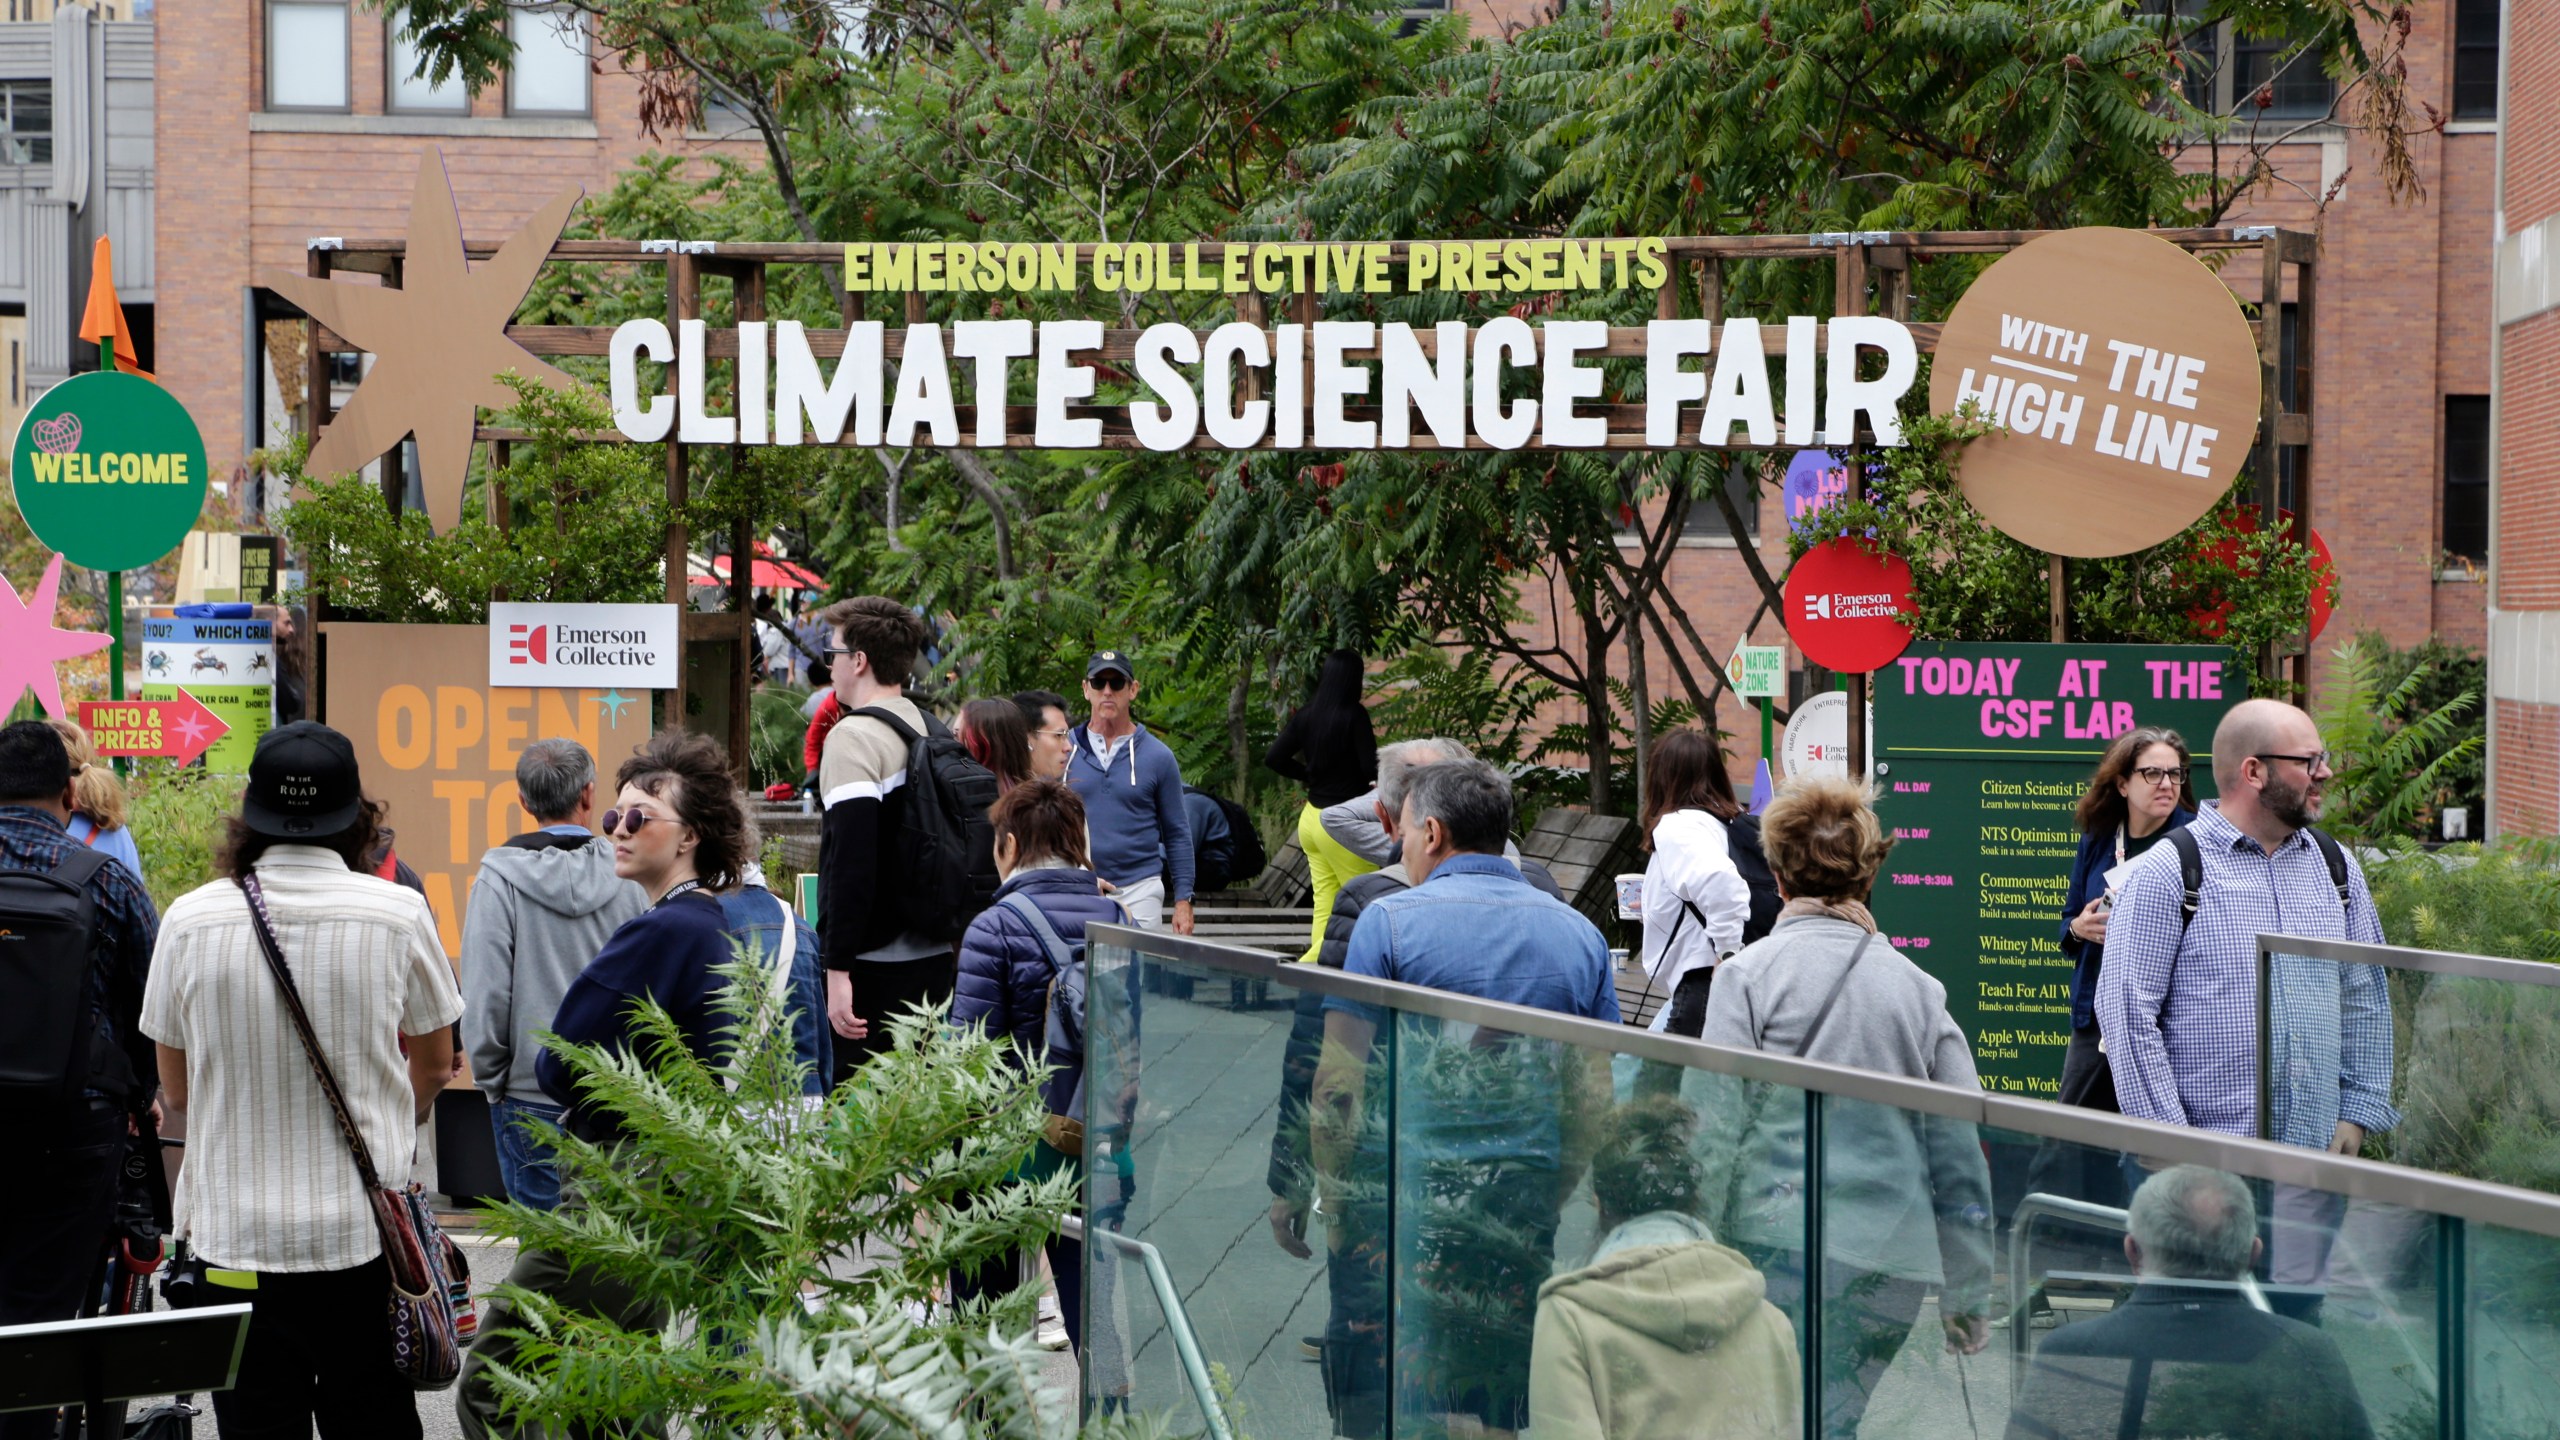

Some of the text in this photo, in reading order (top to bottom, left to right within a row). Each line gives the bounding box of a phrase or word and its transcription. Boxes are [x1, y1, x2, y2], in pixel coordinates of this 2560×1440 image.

[844, 236, 1668, 293] EMERSON COLLECTIVE PRESENTS
[2000, 313, 2206, 410] WITH THE
[609, 316, 1918, 451] CLIMATE SCIENCE FAIR
[1954, 367, 2219, 478] HIGH LINE
[30, 452, 188, 484] WELCOME
[1834, 593, 1892, 606] Emerson
[1834, 606, 1898, 618] Collective
[148, 624, 172, 638] YOU?
[193, 625, 242, 639] WHICH
[555, 624, 647, 645] Emerson
[555, 646, 656, 666] Collective
[1745, 652, 1779, 670] NATURE
[1745, 673, 1769, 691] ZONE
[1897, 657, 2222, 699] TODAY AT THE
[218, 695, 240, 704] CRAB
[92, 708, 162, 728] INFO &
[1981, 699, 2135, 739] CSF LAB
[377, 684, 599, 771] OPEN
[1788, 714, 1807, 751] HARD WORK
[93, 729, 163, 750] PRIZES
[280, 785, 317, 796] ROAD
[1893, 782, 1931, 793] ALL DAY
[1981, 779, 2021, 795] Citizen
[2025, 780, 2073, 796] Scientist
[1981, 799, 2003, 809] Learn
[2004, 799, 2021, 810] how
[2022, 801, 2029, 810] to
[2031, 800, 2060, 811] become
[2062, 803, 2067, 811] a
[1912, 828, 1930, 839] DAY
[1981, 827, 2008, 841] NTS
[2011, 827, 2068, 845] Optimism
[1980, 845, 1999, 855] Soak
[2001, 846, 2008, 856] in
[2016, 846, 2035, 856] sonic
[1892, 874, 1953, 886] 7:30A-9:30A
[1980, 873, 2070, 889] Commonwealth
[666, 881, 699, 900] HIGH LINE
[1980, 890, 2068, 907] Systems Works
[1980, 908, 2000, 919] Build
[2008, 909, 2031, 919] model
[1891, 937, 1931, 948] 10A-12P
[1979, 936, 2061, 955] Whitney Muse
[1979, 955, 1997, 965] Slow
[1999, 955, 2027, 967] looking
[2028, 956, 2042, 966] and
[1979, 982, 2013, 996] Teach
[2016, 983, 2037, 998] For
[2039, 985, 2057, 999] All
[1978, 1001, 2014, 1012] Hands-on
[2015, 1002, 2042, 1013] climate
[1978, 1028, 2012, 1047] Apple
[1978, 1048, 2018, 1060] Deep Field
[1978, 1075, 1998, 1090] NY
[2001, 1076, 2024, 1091] Sun
